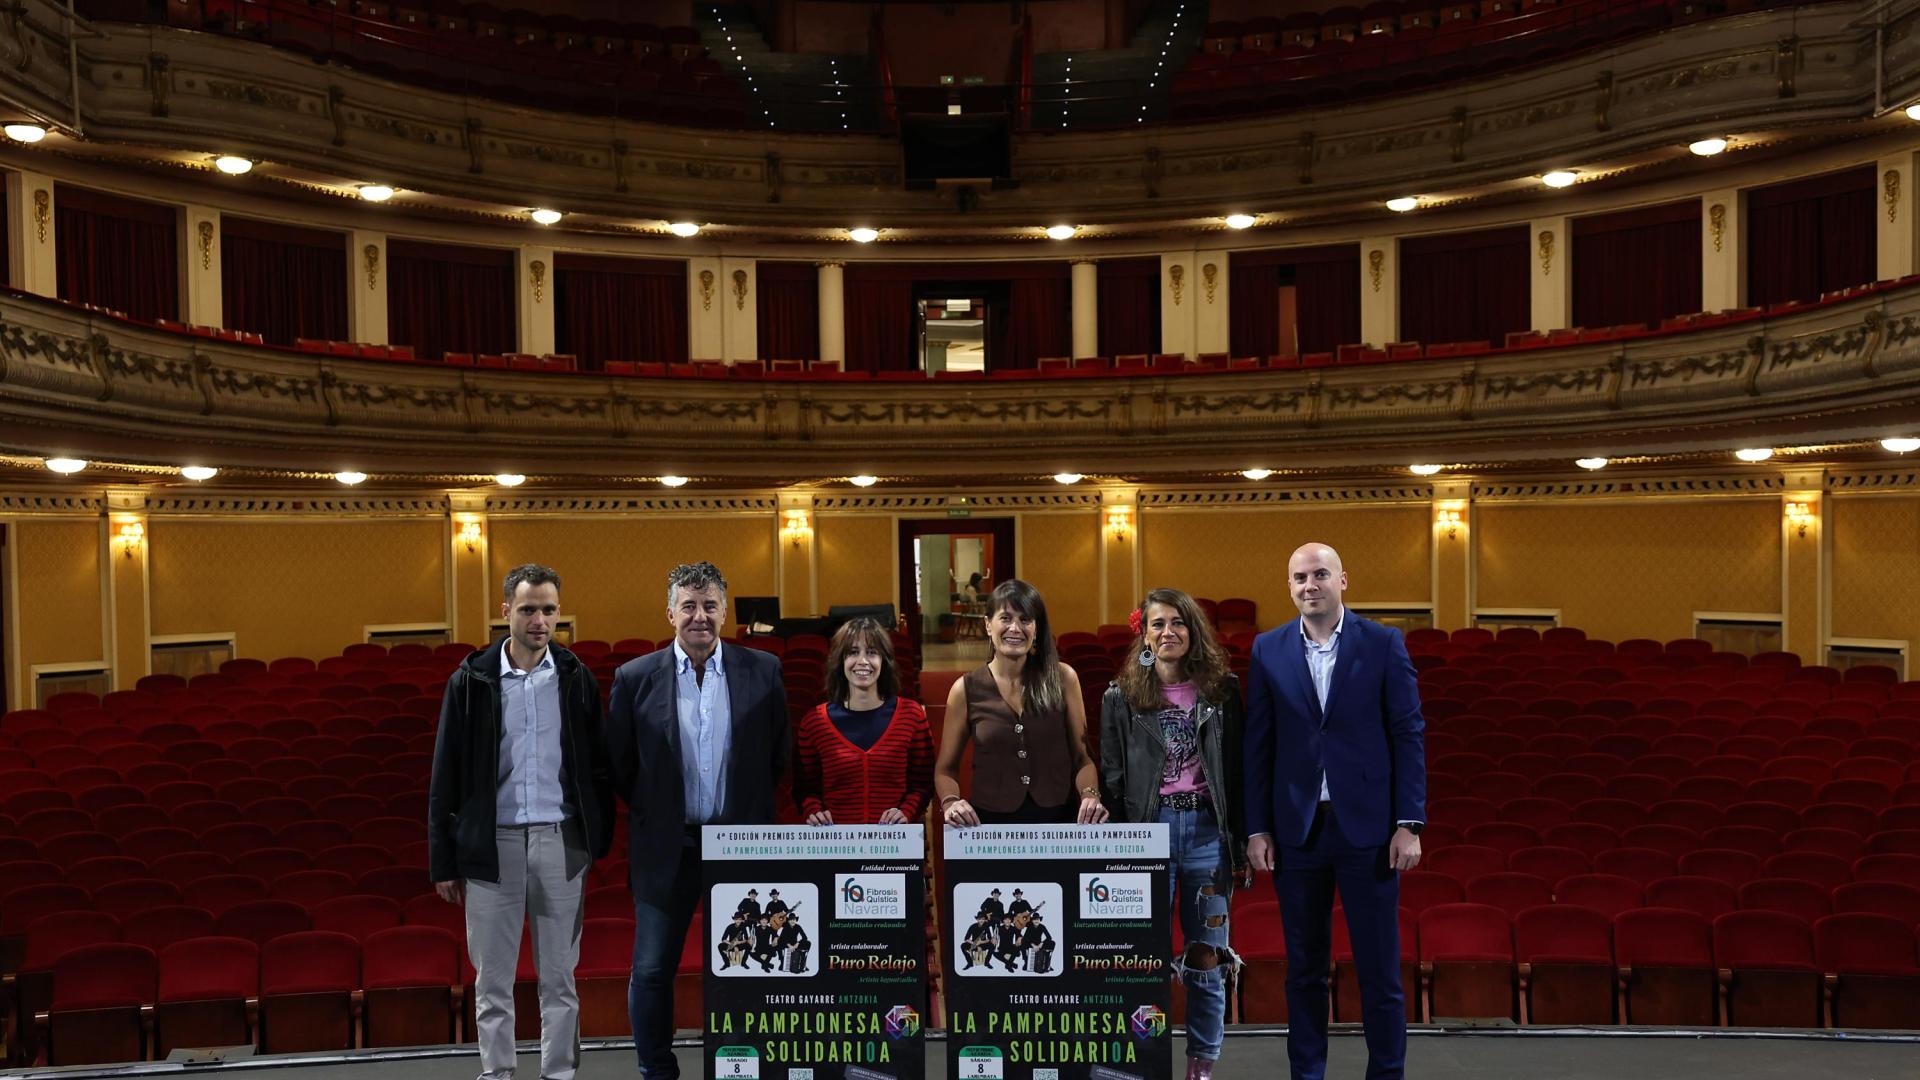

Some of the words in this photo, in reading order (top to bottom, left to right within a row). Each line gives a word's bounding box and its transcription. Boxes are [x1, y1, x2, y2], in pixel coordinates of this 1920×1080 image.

[729, 832, 759, 841] EDICIÓN
[763, 832, 795, 841] PREMIOS
[798, 832, 843, 841] SOLIDARIOS
[846, 832, 854, 840] LA
[857, 831, 907, 840] PAMPLONESA
[971, 831, 1002, 840] EDICIÓN
[1005, 831, 1038, 840] PREMIOS
[1041, 831, 1087, 840] SOLIDARIOS
[1090, 831, 1099, 839] LA
[1103, 830, 1152, 839] PAMPLONESA
[722, 847, 731, 855] LA
[735, 846, 783, 855] PAMPLONESA
[786, 846, 804, 854] SARI
[870, 845, 899, 854] EDIZIOA
[965, 846, 974, 854] LA
[977, 846, 1026, 854] PAMPLONESA
[1030, 845, 1048, 854] SARI
[1115, 845, 1145, 853] EDIZIOA
[866, 888, 898, 896] Fibrosis
[1111, 888, 1143, 896] Fibrosis
[844, 904, 898, 915] Navarra
[1089, 903, 1143, 915] Navarra
[828, 955, 865, 971] Puro
[867, 955, 916, 974] Relajo
[1073, 955, 1110, 971] Puro
[1113, 955, 1163, 974] Relajo
[765, 995, 795, 1004] TEATRO
[798, 995, 835, 1004] GAYARRE
[838, 995, 878, 1004] ANTZOKIA
[1009, 994, 1039, 1004] TEATRO
[1043, 994, 1080, 1004] GAYARRE
[1083, 994, 1124, 1004] ANTZOKIA
[711, 1012, 733, 1034] LA
[745, 1012, 881, 1034] PAMPLONESA
[954, 1012, 976, 1034] LA
[989, 1012, 1127, 1034] PAMPLONESA
[766, 1041, 890, 1063] SOLIDARIOA
[1010, 1041, 1136, 1063] SOLIDARIOA
[734, 1063, 740, 1074] 8
[977, 1063, 984, 1074] 8
